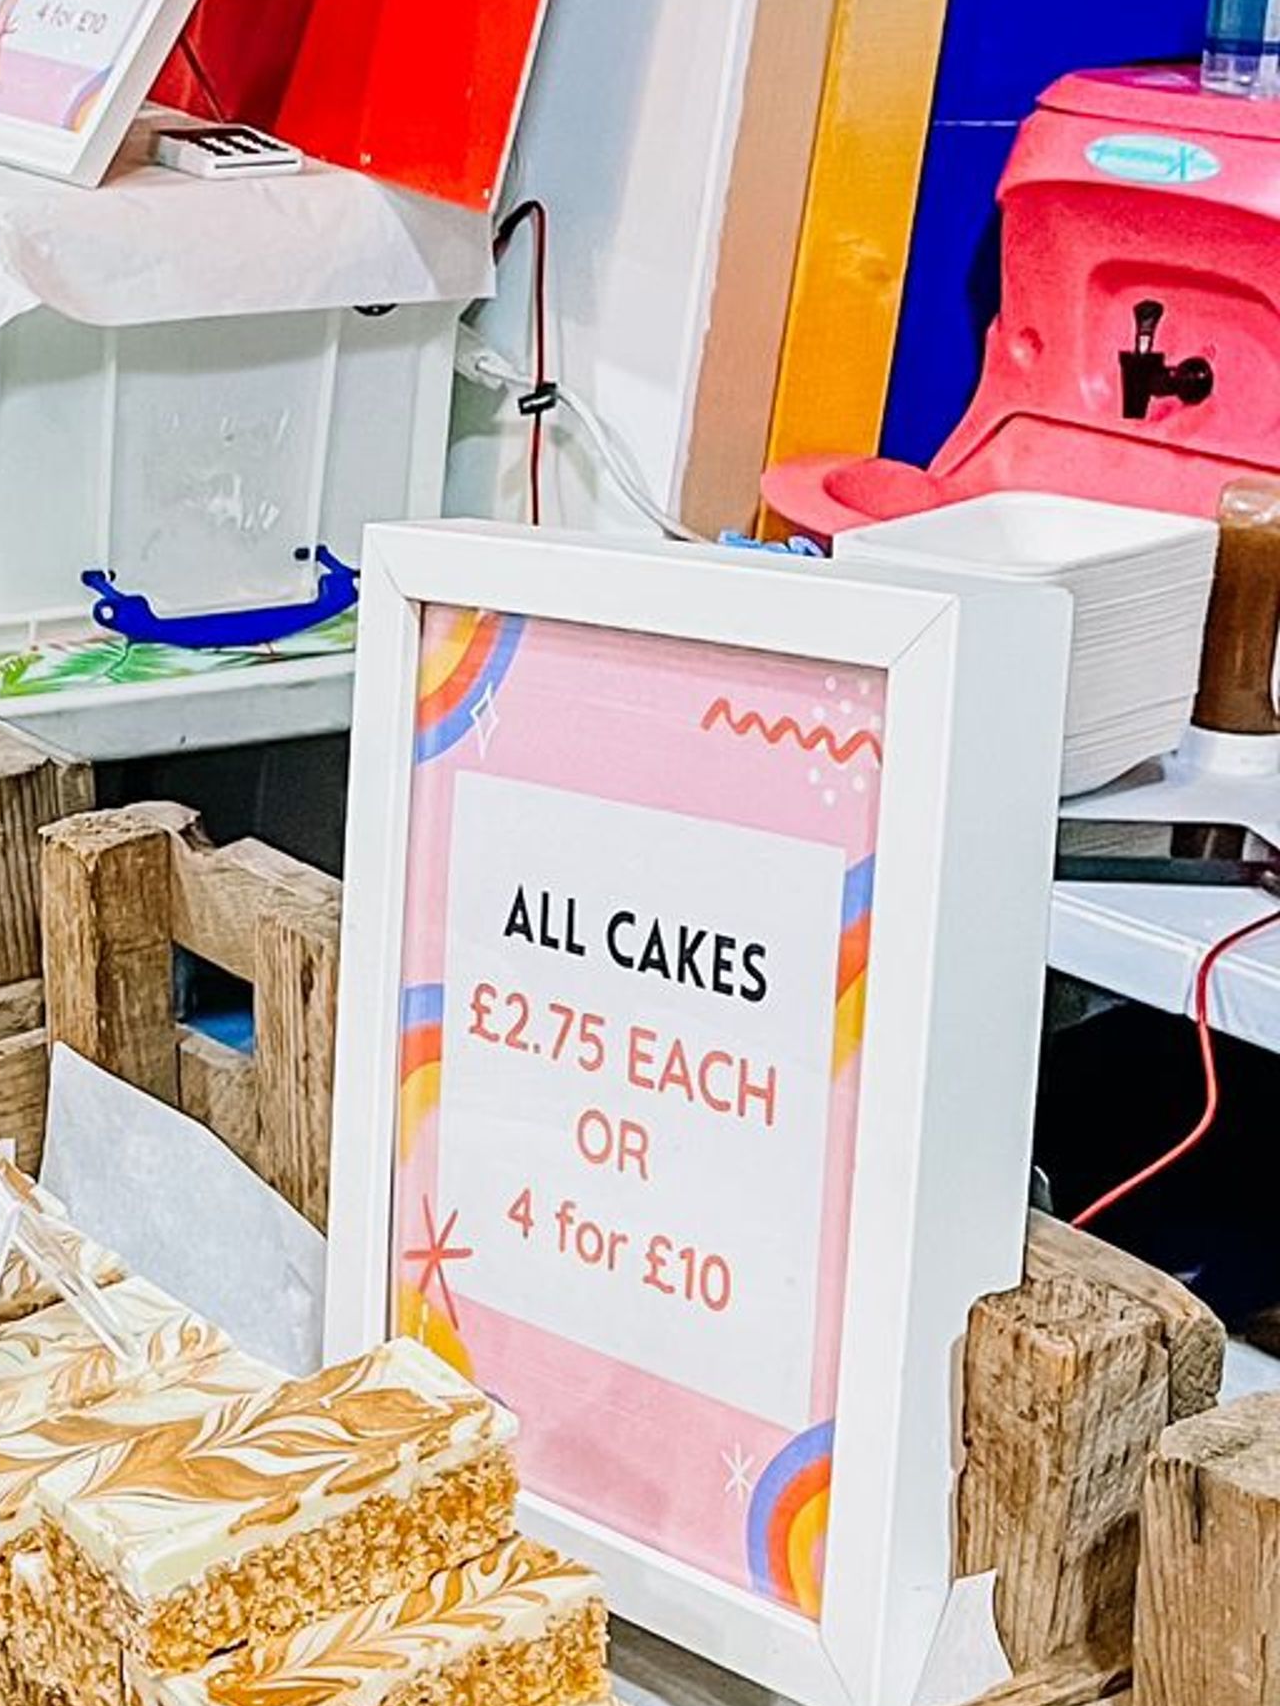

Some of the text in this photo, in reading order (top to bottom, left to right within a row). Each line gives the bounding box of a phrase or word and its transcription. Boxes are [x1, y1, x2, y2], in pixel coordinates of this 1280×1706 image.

[503, 884, 770, 1005] ALL CAKES
[467, 982, 778, 1129] £2.75 EACH
[575, 1107, 652, 1183] OR
[506, 1184, 732, 1314] 4 for £10
